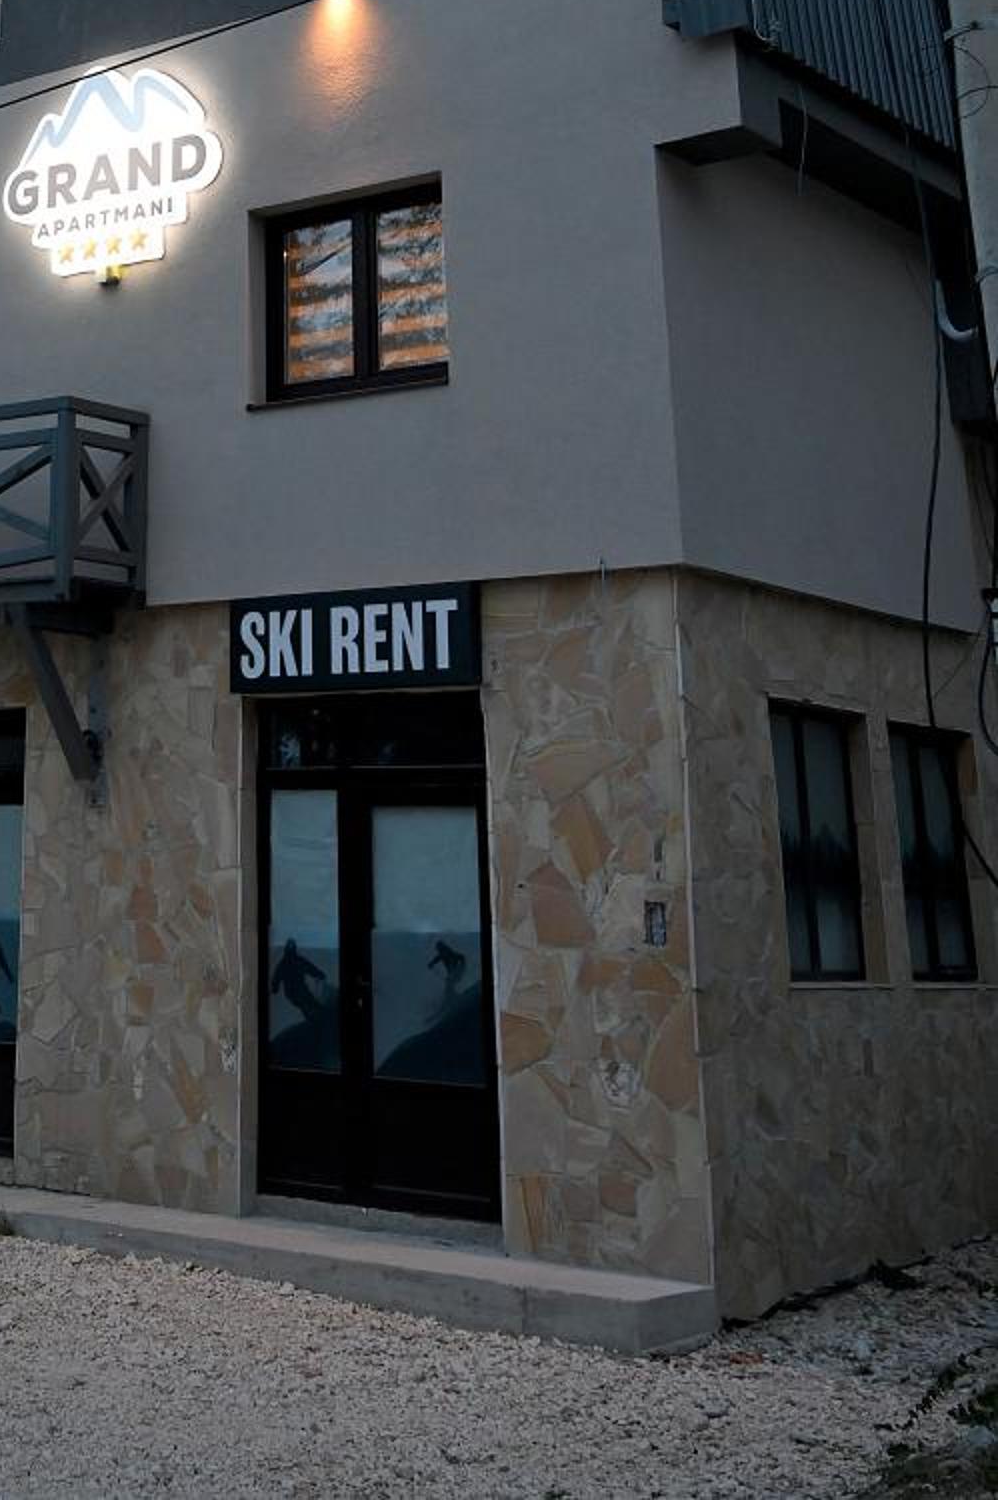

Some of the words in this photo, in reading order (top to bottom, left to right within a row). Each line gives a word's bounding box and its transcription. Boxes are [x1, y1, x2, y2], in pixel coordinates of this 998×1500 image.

[7, 132, 208, 216] GRAND
[37, 197, 173, 240] APARTMANI
[239, 608, 313, 680] SKI
[329, 599, 458, 676] RENT
